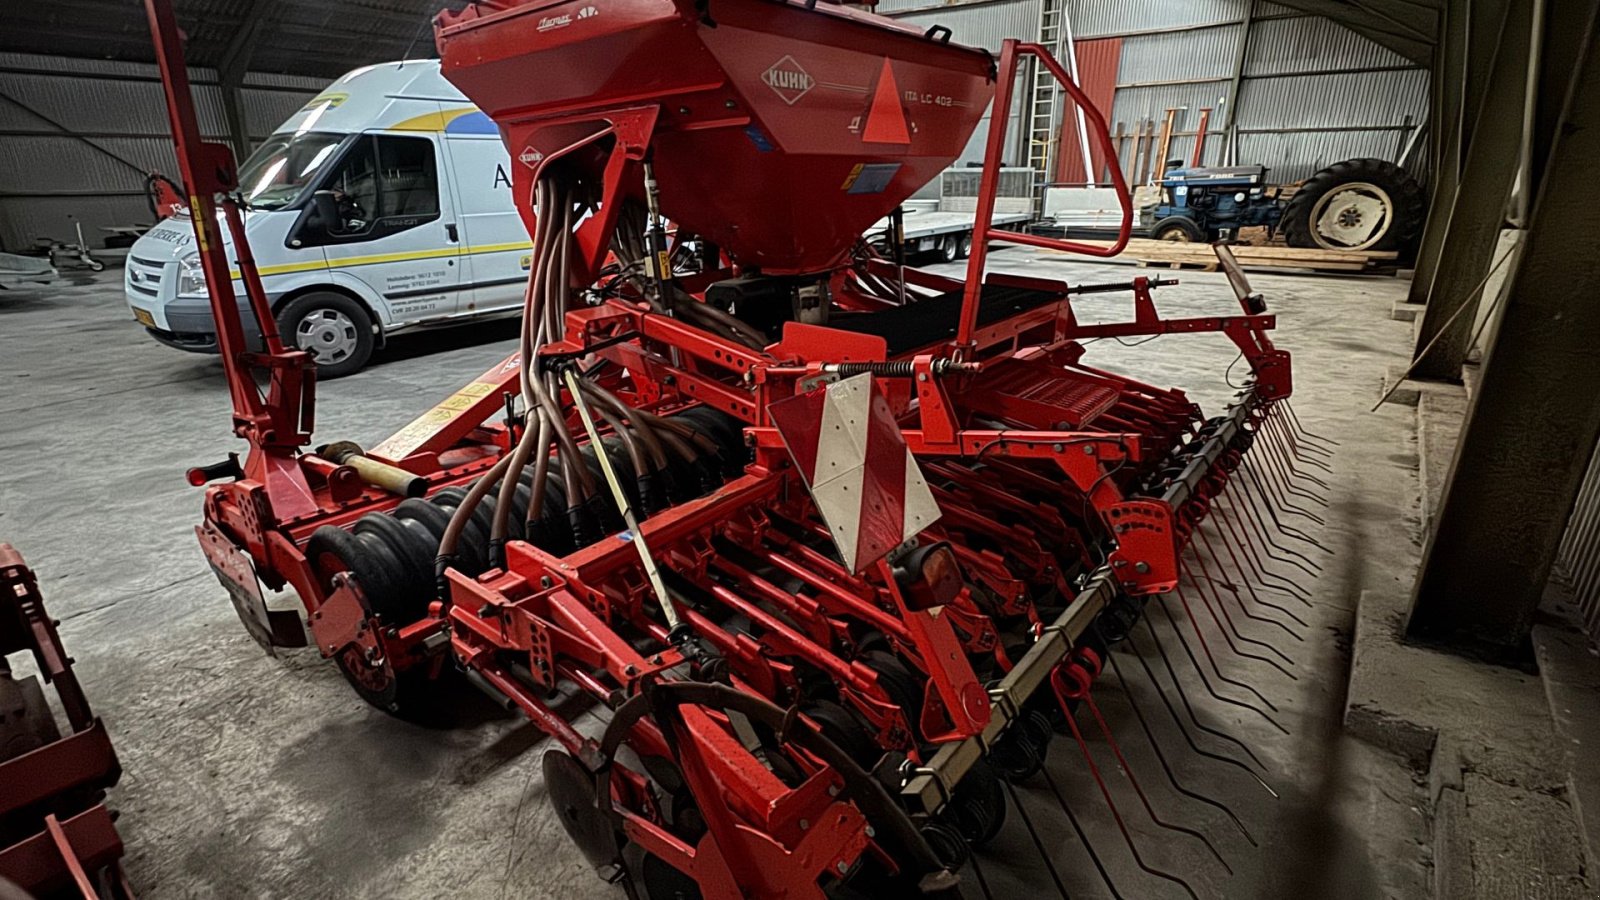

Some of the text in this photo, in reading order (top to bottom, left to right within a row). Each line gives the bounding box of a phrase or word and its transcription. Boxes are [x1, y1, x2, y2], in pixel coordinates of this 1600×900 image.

[768, 69, 808, 90] KUHN
[904, 91, 953, 107] ITA LC 402
